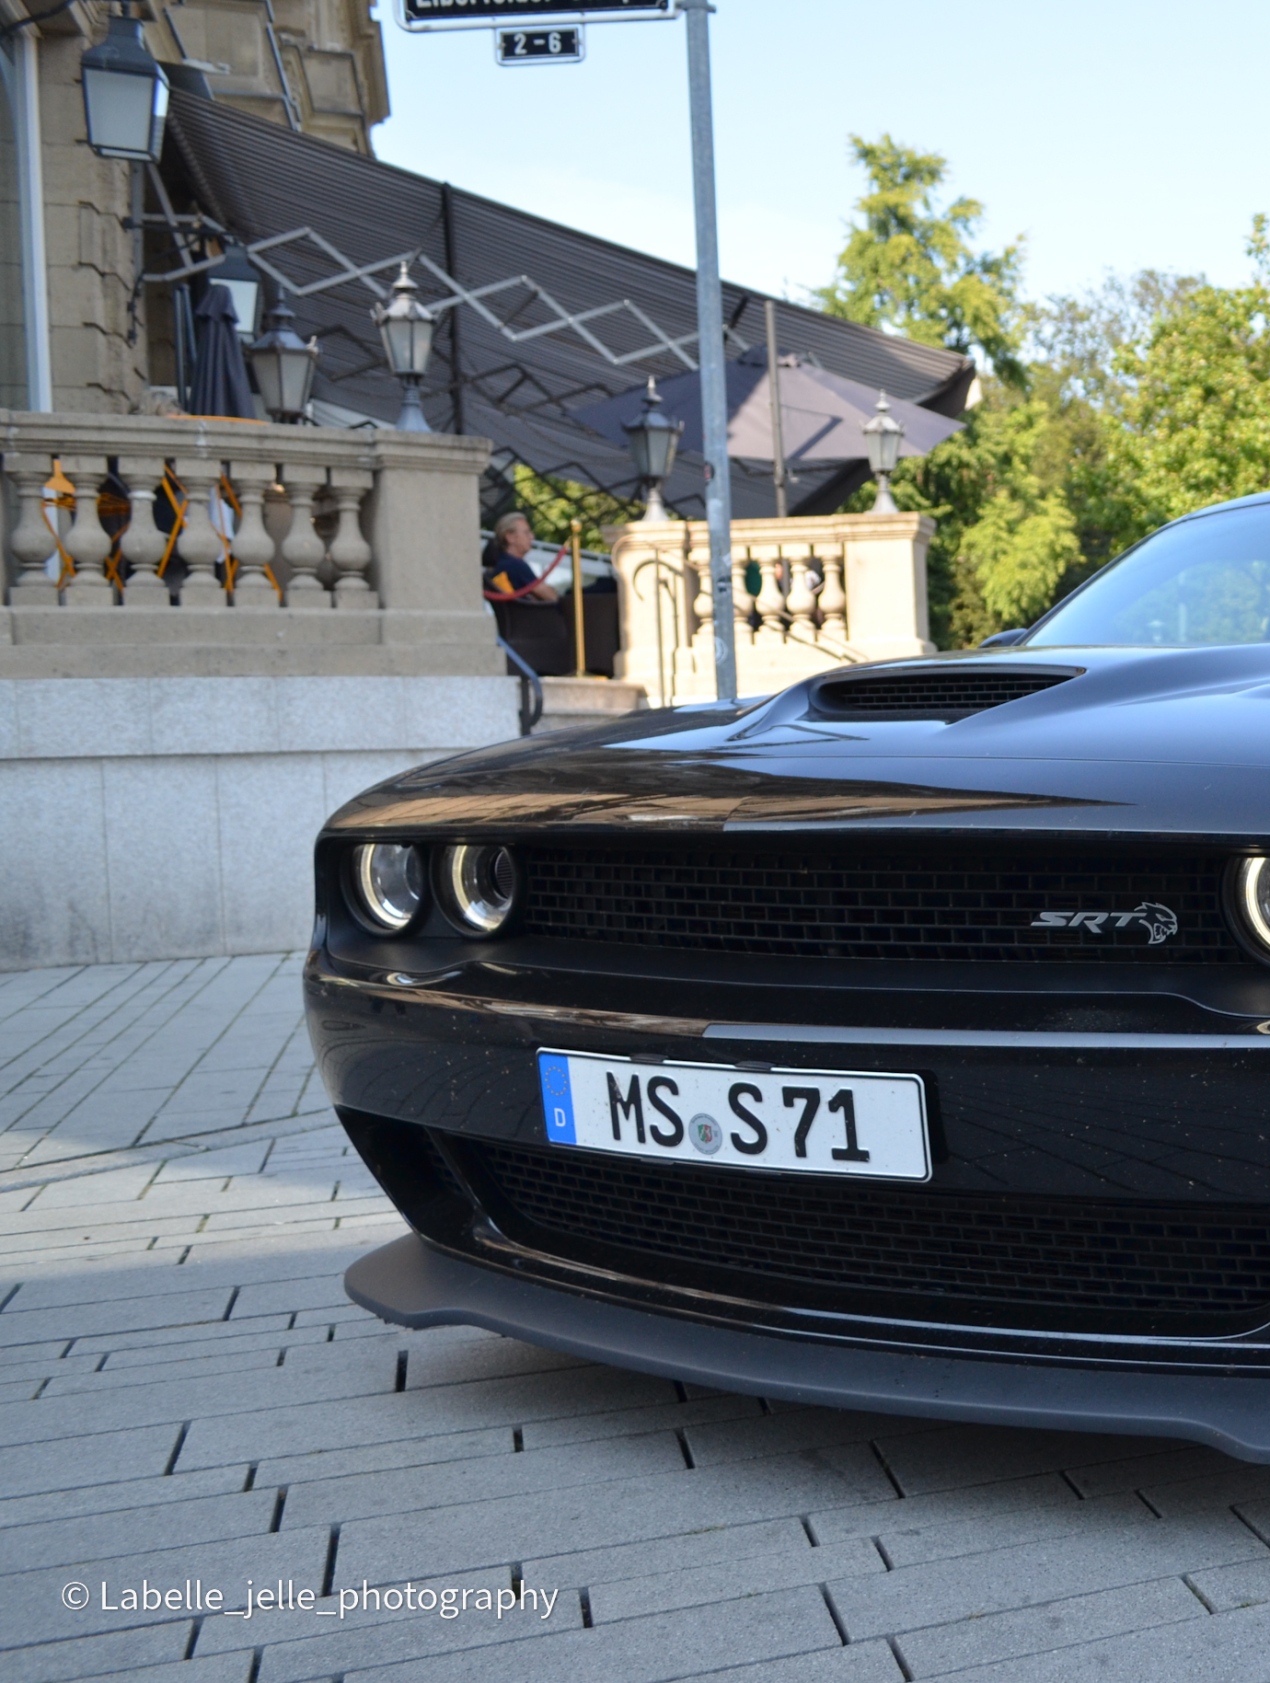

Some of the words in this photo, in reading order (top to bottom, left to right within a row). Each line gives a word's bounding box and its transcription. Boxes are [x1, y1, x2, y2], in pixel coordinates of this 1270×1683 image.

[1030, 911, 1148, 934] SRT
[553, 1107, 567, 1128] D
[605, 1070, 685, 1149] MS
